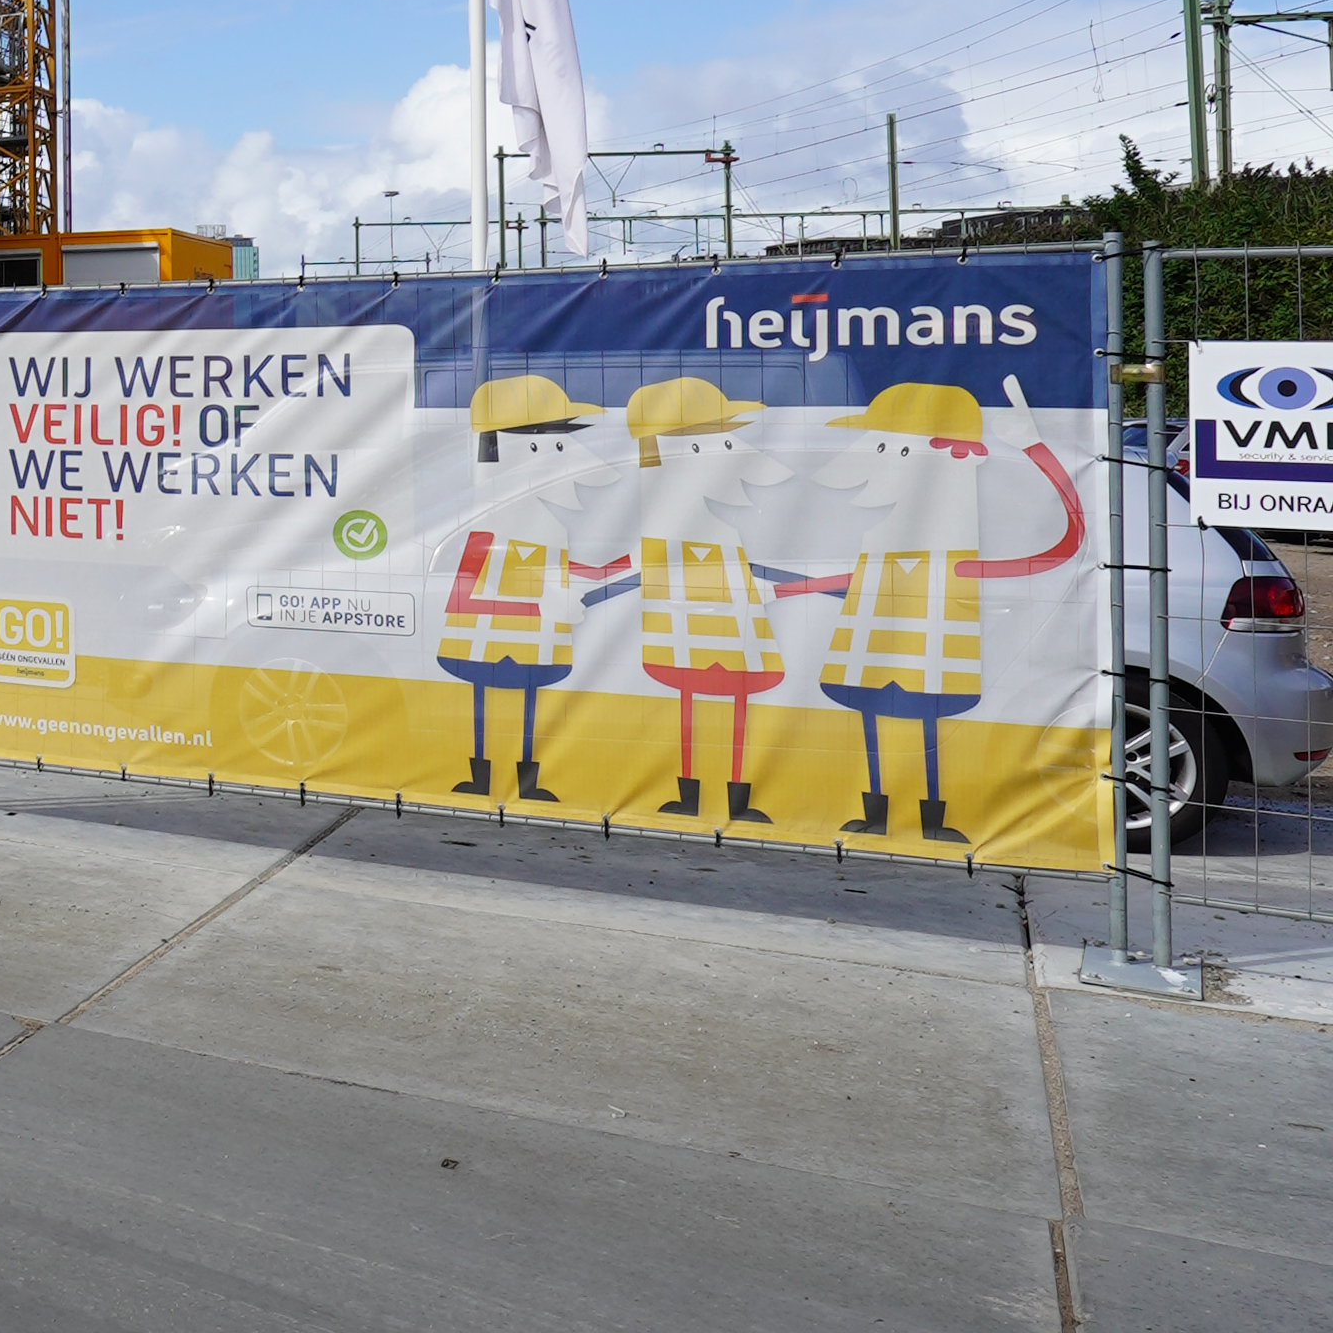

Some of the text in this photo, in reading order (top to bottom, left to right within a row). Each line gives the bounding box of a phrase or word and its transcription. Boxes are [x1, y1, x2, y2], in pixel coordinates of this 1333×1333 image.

[706, 294, 1037, 361] heijmans
[9, 353, 351, 398] WIJ WERKEN
[9, 404, 261, 448] VEILIG! OF
[1239, 451, 1284, 461] security
[1288, 453, 1297, 461] &
[9, 449, 338, 497] WE WERKEN
[10, 495, 124, 541] NIET!
[1218, 493, 1333, 514] BIJ ONRA
[280, 595, 371, 612] GO! APP NU
[280, 609, 406, 629] IN JE APPSTORE
[17, 655, 66, 667] ONGEVALLEN
